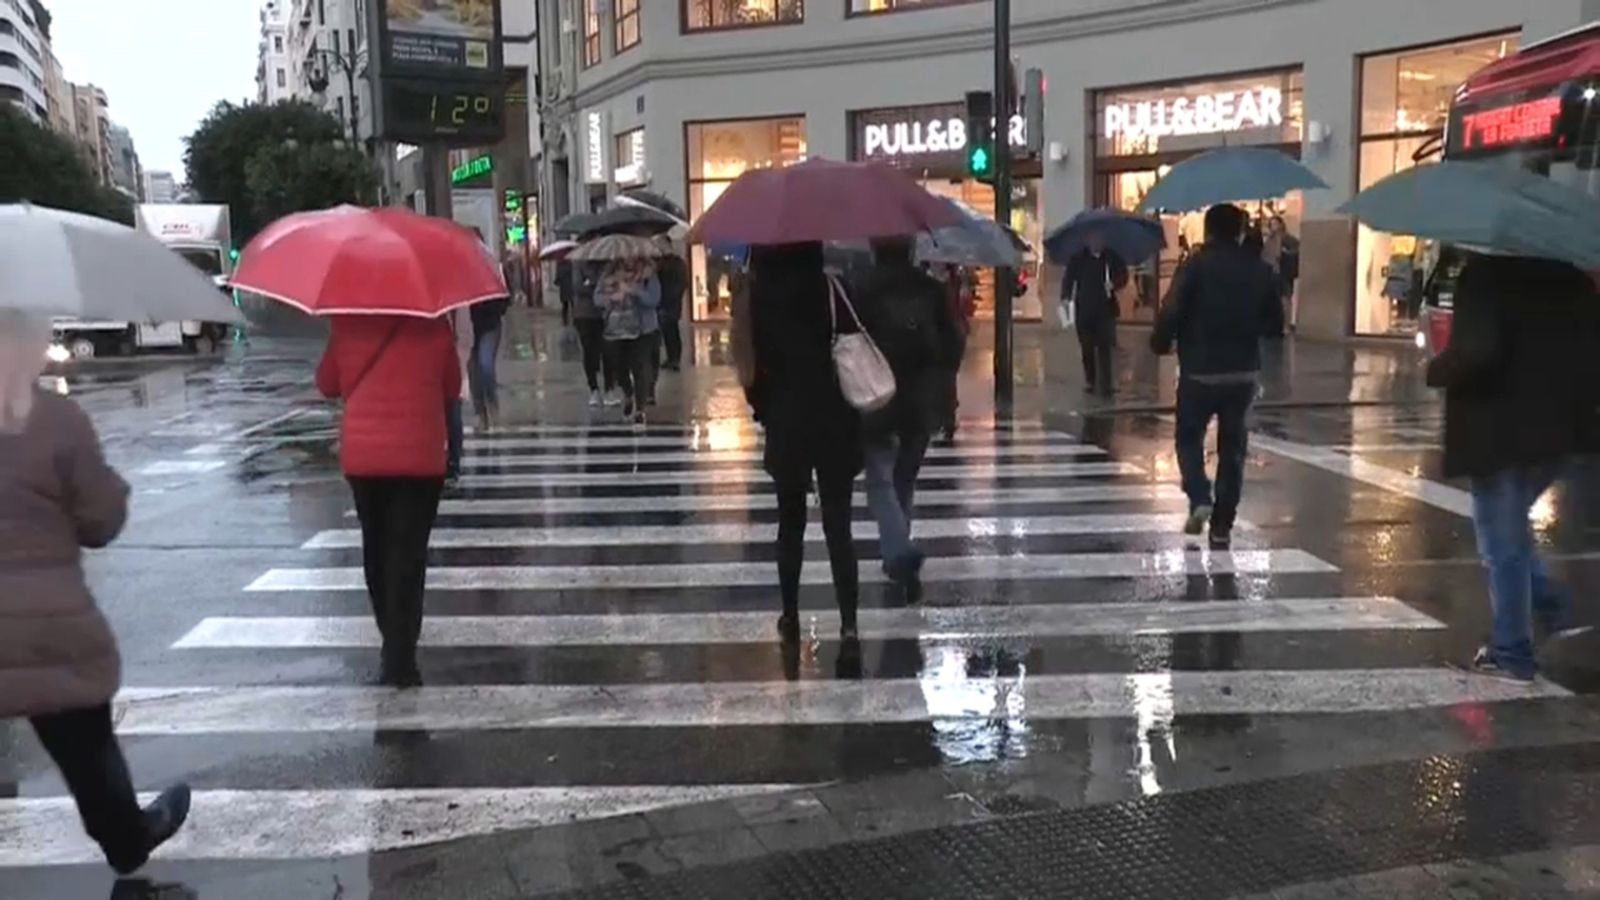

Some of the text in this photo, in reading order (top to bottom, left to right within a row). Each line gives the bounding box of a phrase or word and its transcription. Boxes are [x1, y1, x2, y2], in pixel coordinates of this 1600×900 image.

[1105, 86, 1282, 139] PULL&BEAR
[1463, 114, 1475, 149] 7
[865, 115, 1026, 156] PULL&BR
